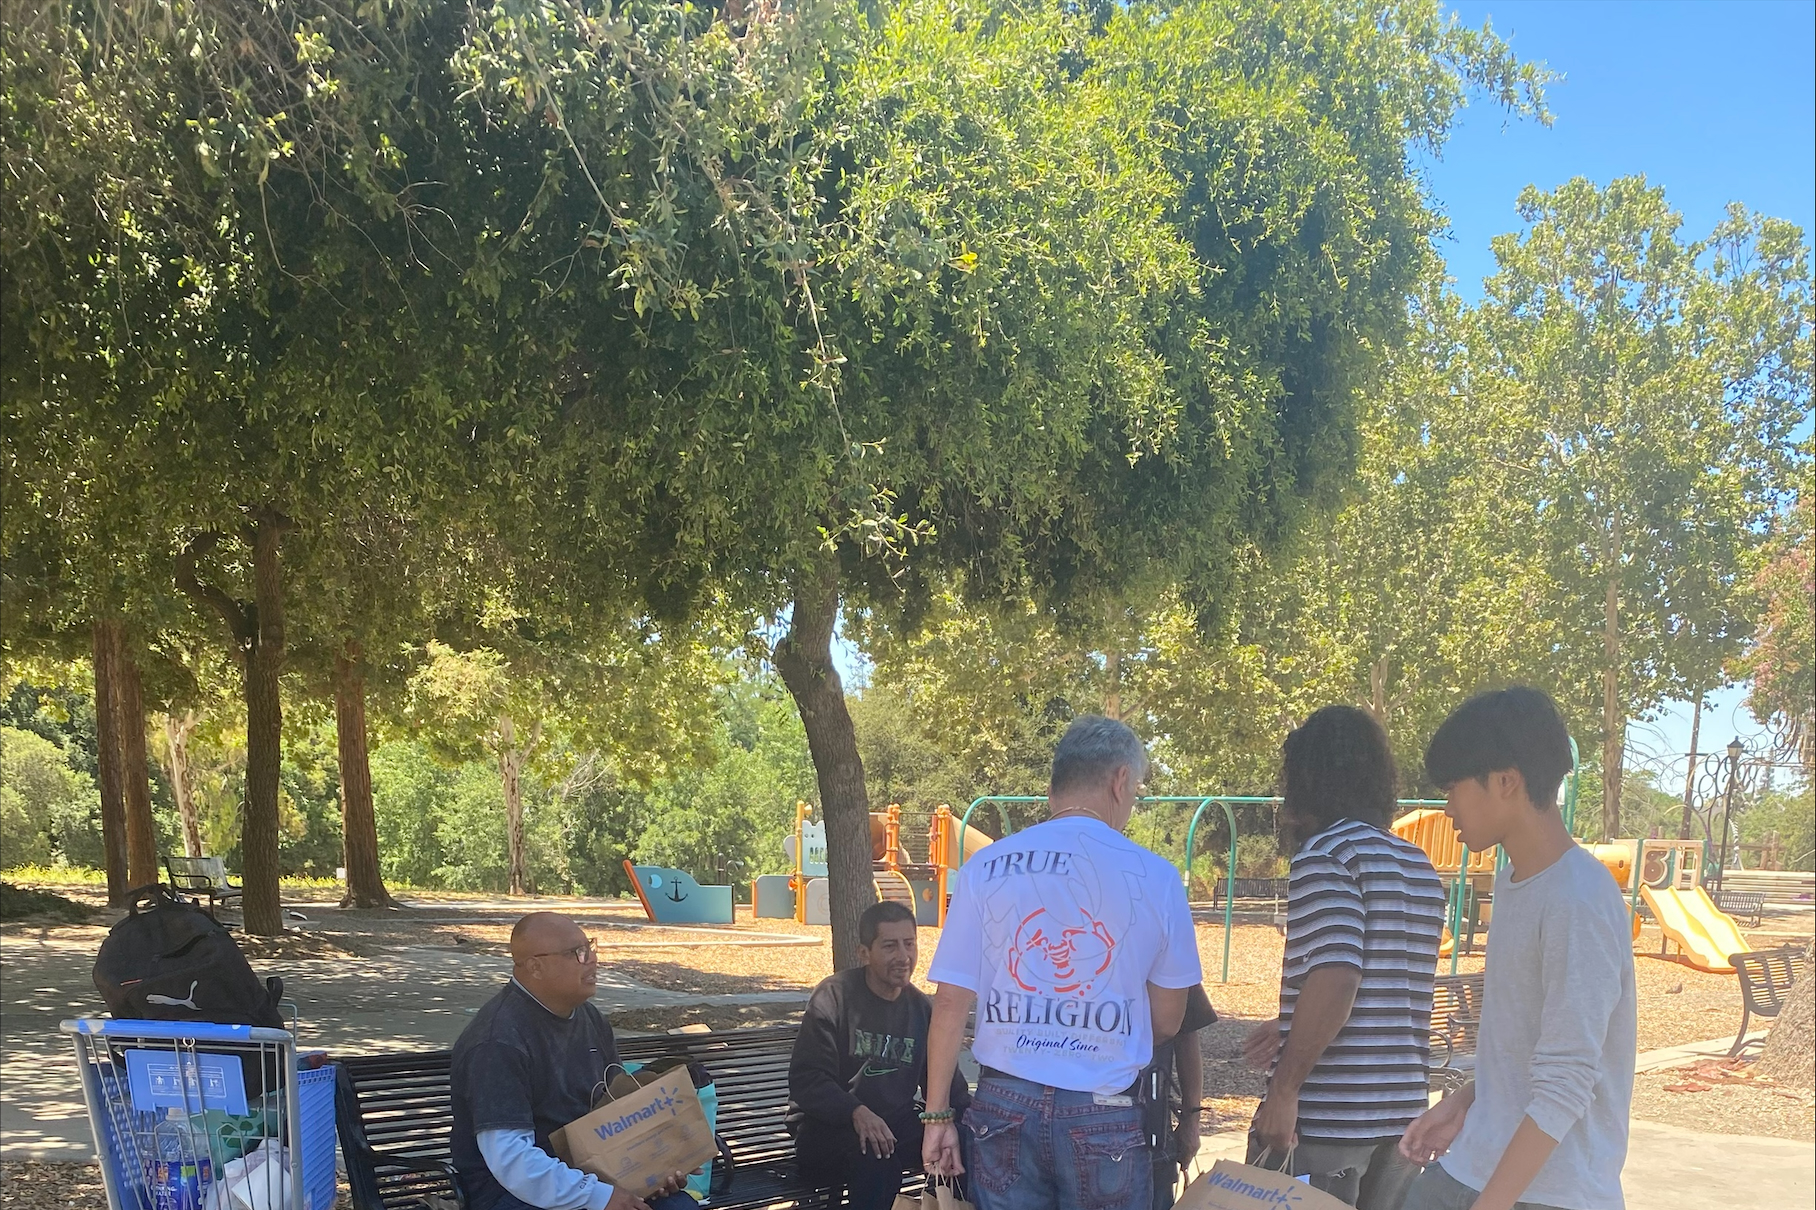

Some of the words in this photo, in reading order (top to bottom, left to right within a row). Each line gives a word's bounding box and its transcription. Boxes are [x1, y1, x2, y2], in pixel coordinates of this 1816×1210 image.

[984, 850, 1072, 882] TRUE
[985, 987, 1135, 1036] RELIGION
[855, 1028, 915, 1063] NIKE
[1016, 1034, 1069, 1051] Original
[1069, 1038, 1099, 1052] Since
